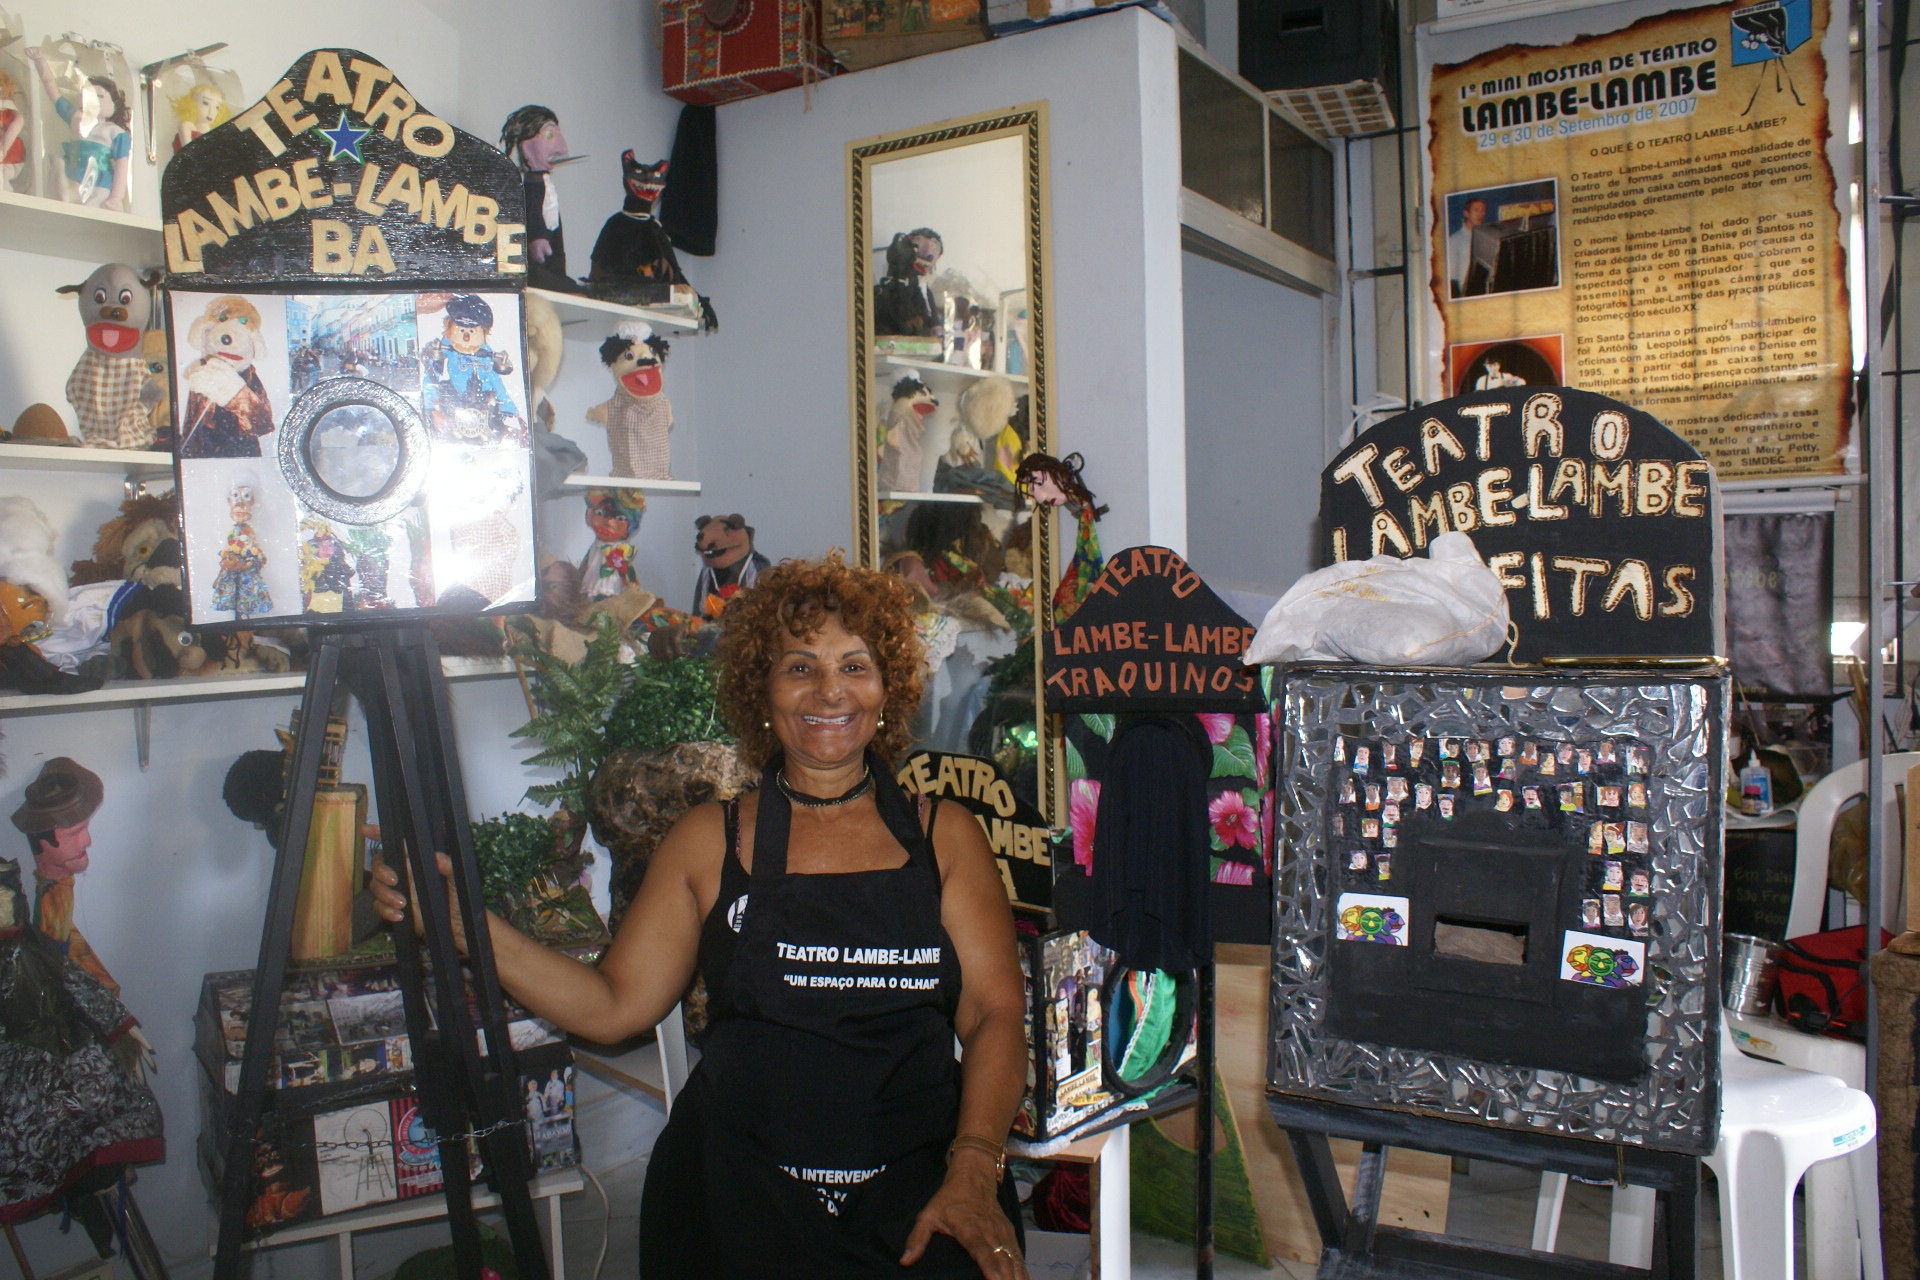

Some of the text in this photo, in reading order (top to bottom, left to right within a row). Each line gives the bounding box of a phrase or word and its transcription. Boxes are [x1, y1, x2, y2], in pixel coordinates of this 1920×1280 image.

[1482, 75, 1521, 96] MINI
[1528, 60, 1602, 87] MOSTRA
[1609, 50, 1634, 71] DE
[1640, 38, 1717, 65] TEATRO
[233, 51, 455, 157] TEATRO
[1463, 60, 1716, 132] LAMBE-LAMBE
[1479, 97, 1697, 148] 29 e 30 de Setembro de 2007
[1582, 169, 1612, 180] Teatro
[1619, 155, 1691, 174] Lambe-Lambe
[1704, 151, 1726, 161] uma
[1729, 139, 1793, 157] modalidade
[1601, 143, 1622, 155] QUE
[1648, 132, 1691, 147] TEATRO
[1571, 182, 1600, 192] teatro
[1627, 172, 1663, 184] formas
[1672, 162, 1722, 177] animadas
[1731, 158, 1751, 170] que
[1760, 149, 1811, 163] acontece
[1572, 193, 1604, 204] dentro
[1622, 187, 1643, 196] uma
[1647, 182, 1674, 192] caixa
[1677, 178, 1700, 188] com
[1703, 171, 1749, 184] bonecos
[1572, 198, 1636, 214] manipulados
[1643, 188, 1704, 204] diretamente
[1711, 183, 1734, 197] pelo
[1741, 180, 1762, 190] ator
[163, 157, 527, 274] LAMBE-LAMBE
[1573, 212, 1616, 225] reduzido
[1590, 208, 1813, 244] nome lambe-lambe foi dado por suas
[311, 219, 396, 274] BA
[1574, 245, 1620, 257] criadoras
[1624, 240, 1658, 251] Ismine
[1662, 237, 1687, 246] Lima
[1701, 230, 1737, 241] Denise
[1755, 223, 1794, 234] Santos
[1574, 260, 1590, 268] fim
[1610, 252, 1646, 264] década
[1739, 240, 1757, 250] por
[1762, 235, 1795, 245] causa
[1575, 270, 1603, 279] forma
[1626, 263, 1652, 273] caixa
[1657, 261, 1679, 269] com
[1685, 255, 1727, 266] cortinas
[1733, 252, 1753, 263] que
[1759, 246, 1800, 257] cobrem
[1575, 259, 1791, 291] espectador manipulador que
[1576, 267, 1814, 301] assemelham antigas câmeras dos
[1576, 279, 1815, 312] fotógrafos Lambe-Lambe das praças públicas
[1647, 304, 1681, 315] século
[1577, 346, 1590, 355] foi
[1598, 342, 1638, 353] Antônio
[1705, 333, 1731, 345] após
[1741, 328, 1793, 342] participar
[1596, 332, 1624, 342] Santa
[1628, 328, 1670, 339] Catarina
[1683, 322, 1727, 336] primeiro
[1577, 339, 1796, 366] oficinas com criadoras Ismine Denise
[1644, 354, 1763, 373] partir caixas
[1578, 362, 1797, 388] multiplicado tem tido presença constante
[1702, 375, 1786, 391] principalmente
[1796, 374, 1817, 382] aos
[1646, 396, 1681, 405] formas
[1333, 392, 1630, 508] TEATRO
[1331, 457, 1709, 563] LAMBE-LAMBE
[1092, 547, 1201, 599] TEATRO
[897, 753, 1016, 817] TEATRO
[777, 942, 838, 962] TEATRO
[810, 976, 854, 990] ESPAÇO
[856, 976, 886, 989] PARA
[888, 977, 897, 989] O
